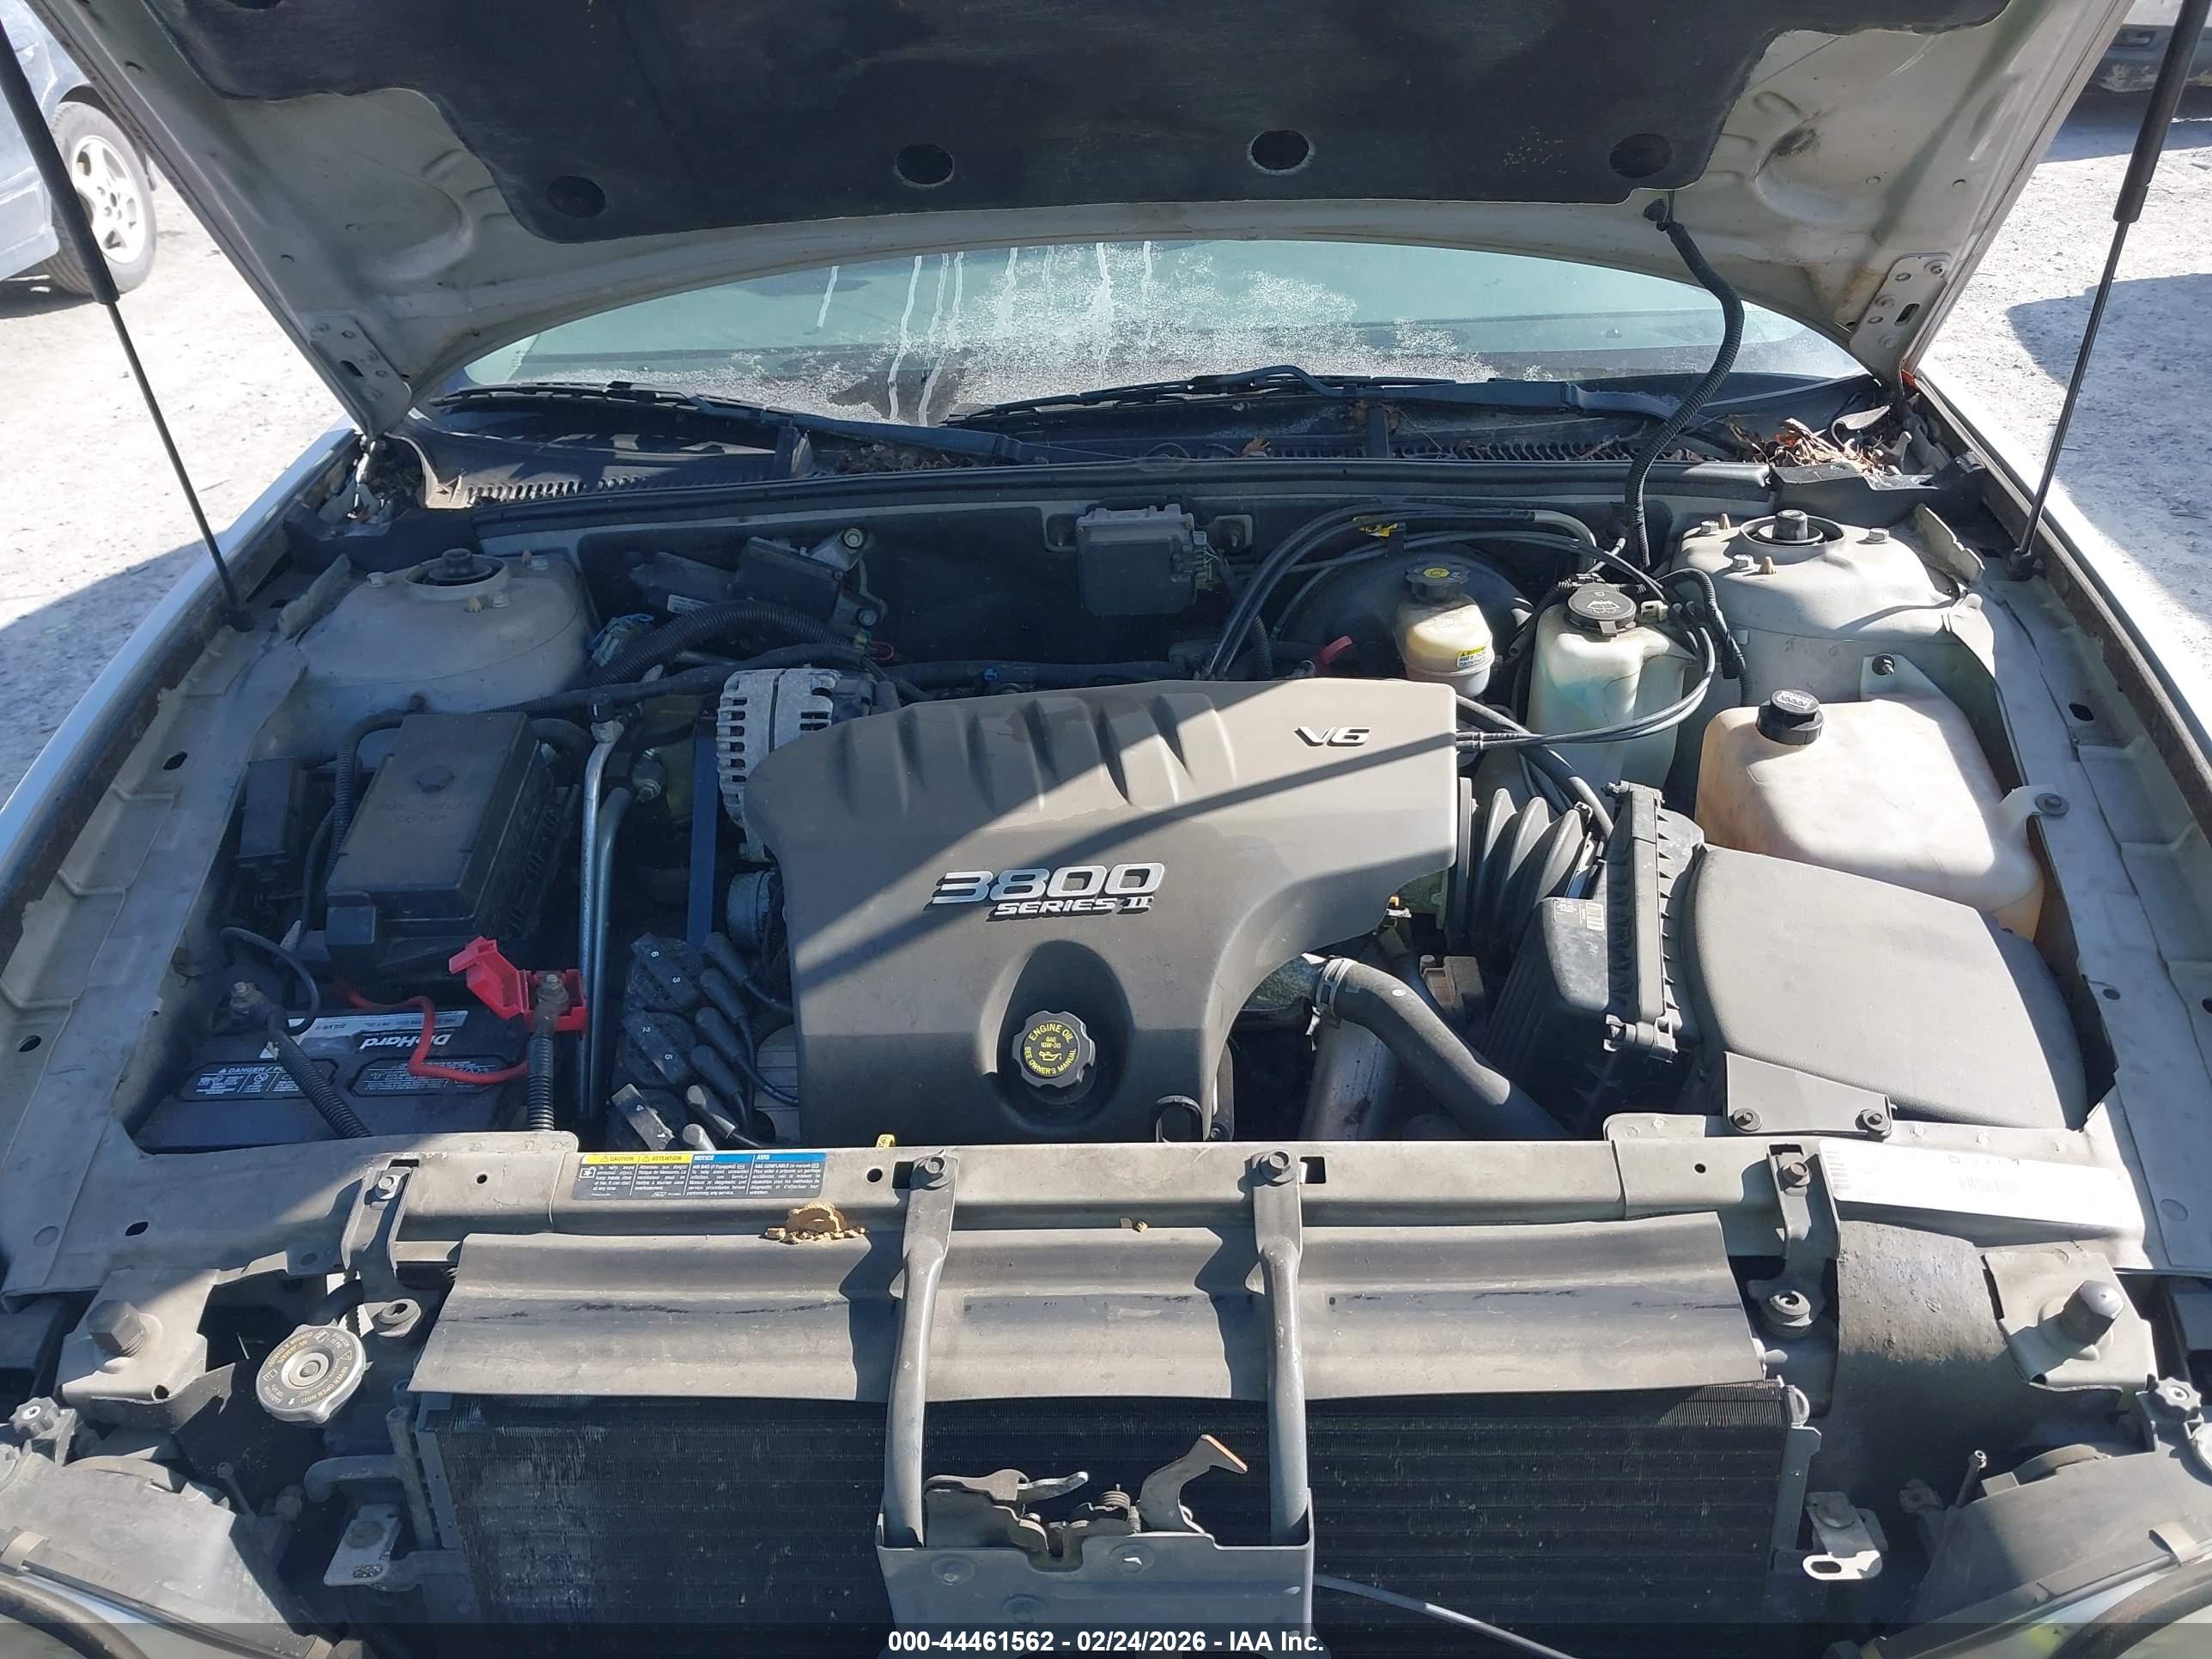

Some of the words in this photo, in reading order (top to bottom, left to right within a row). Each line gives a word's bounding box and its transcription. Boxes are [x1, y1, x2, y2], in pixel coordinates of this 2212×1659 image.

[1293, 726, 1371, 746] V6
[932, 862, 1165, 904] 3800
[994, 897, 1117, 915] SERIES
[1029, 1024, 1062, 1041] ENGINE
[1061, 1030, 1074, 1043] OIL
[1029, 1060, 1056, 1074] OWNER'S
[1057, 1048, 1076, 1073] MANUAL
